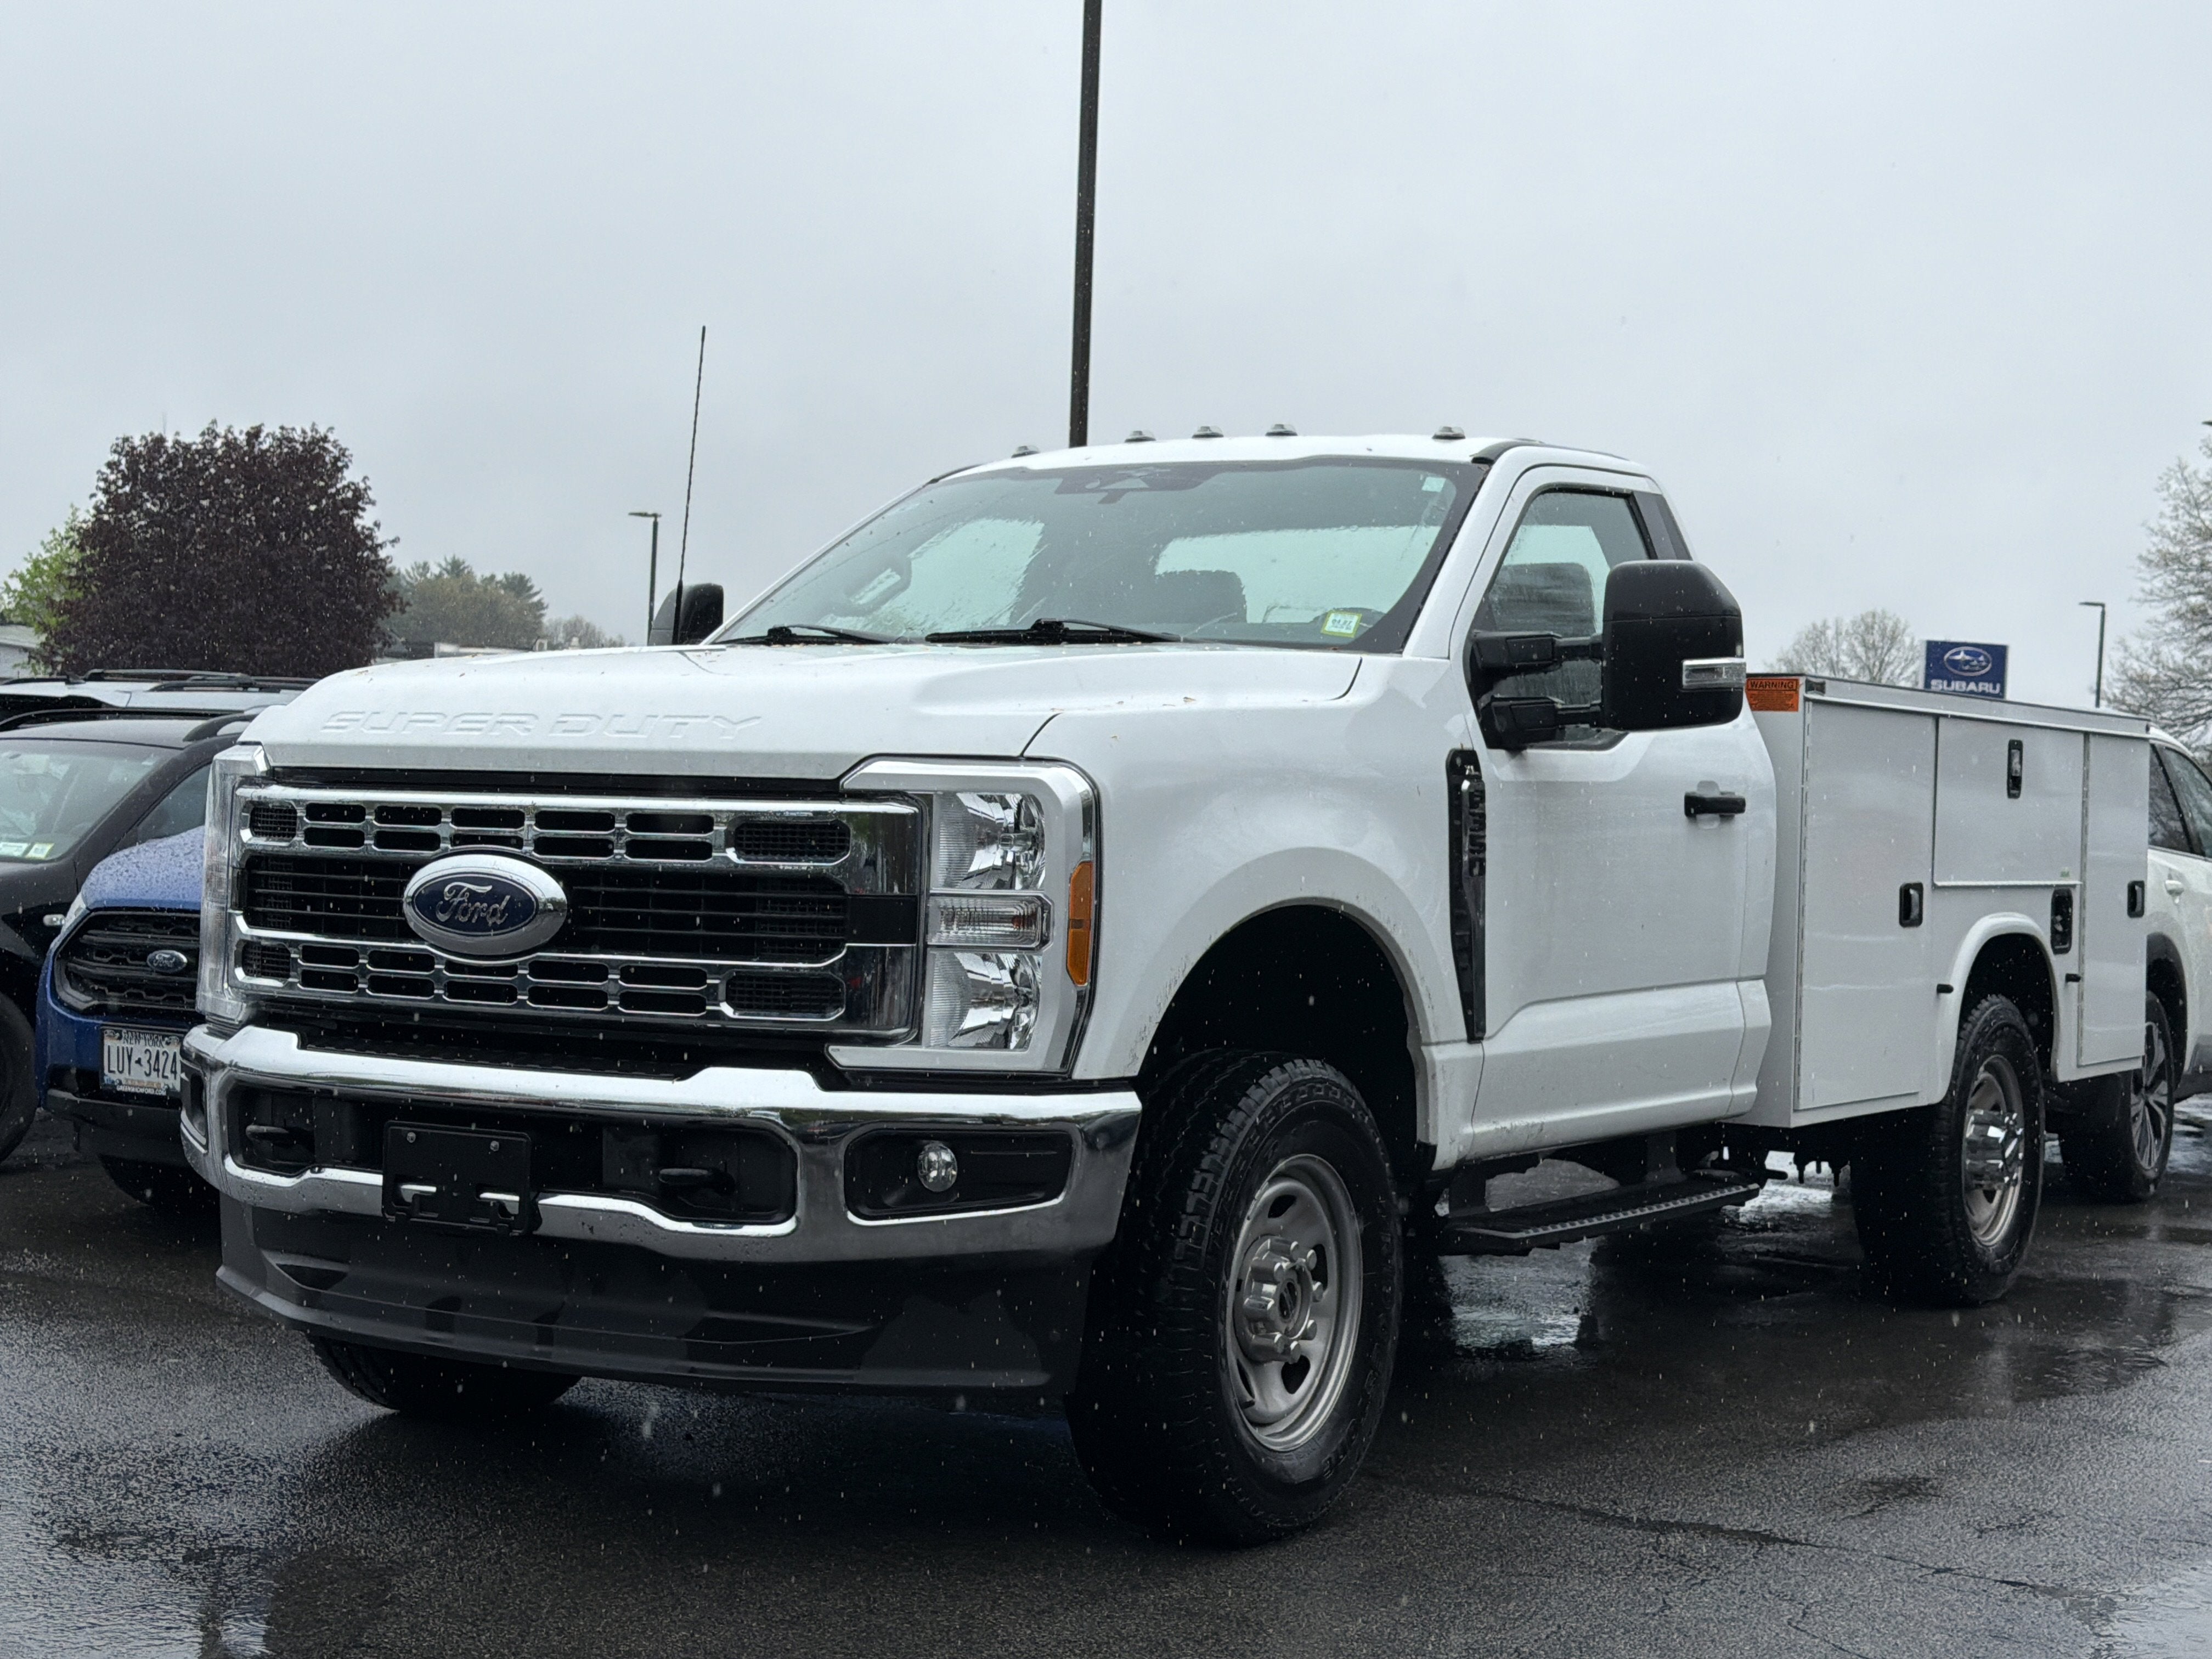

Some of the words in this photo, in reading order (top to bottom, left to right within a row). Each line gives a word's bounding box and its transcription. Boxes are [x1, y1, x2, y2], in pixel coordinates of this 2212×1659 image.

[1750, 680, 1794, 689] WARNING
[1930, 679, 2001, 694] SUBARU
[320, 711, 539, 736] SUPER
[549, 714, 761, 738] DUTY
[436, 882, 511, 927] Ford
[154, 953, 176, 967] Ford
